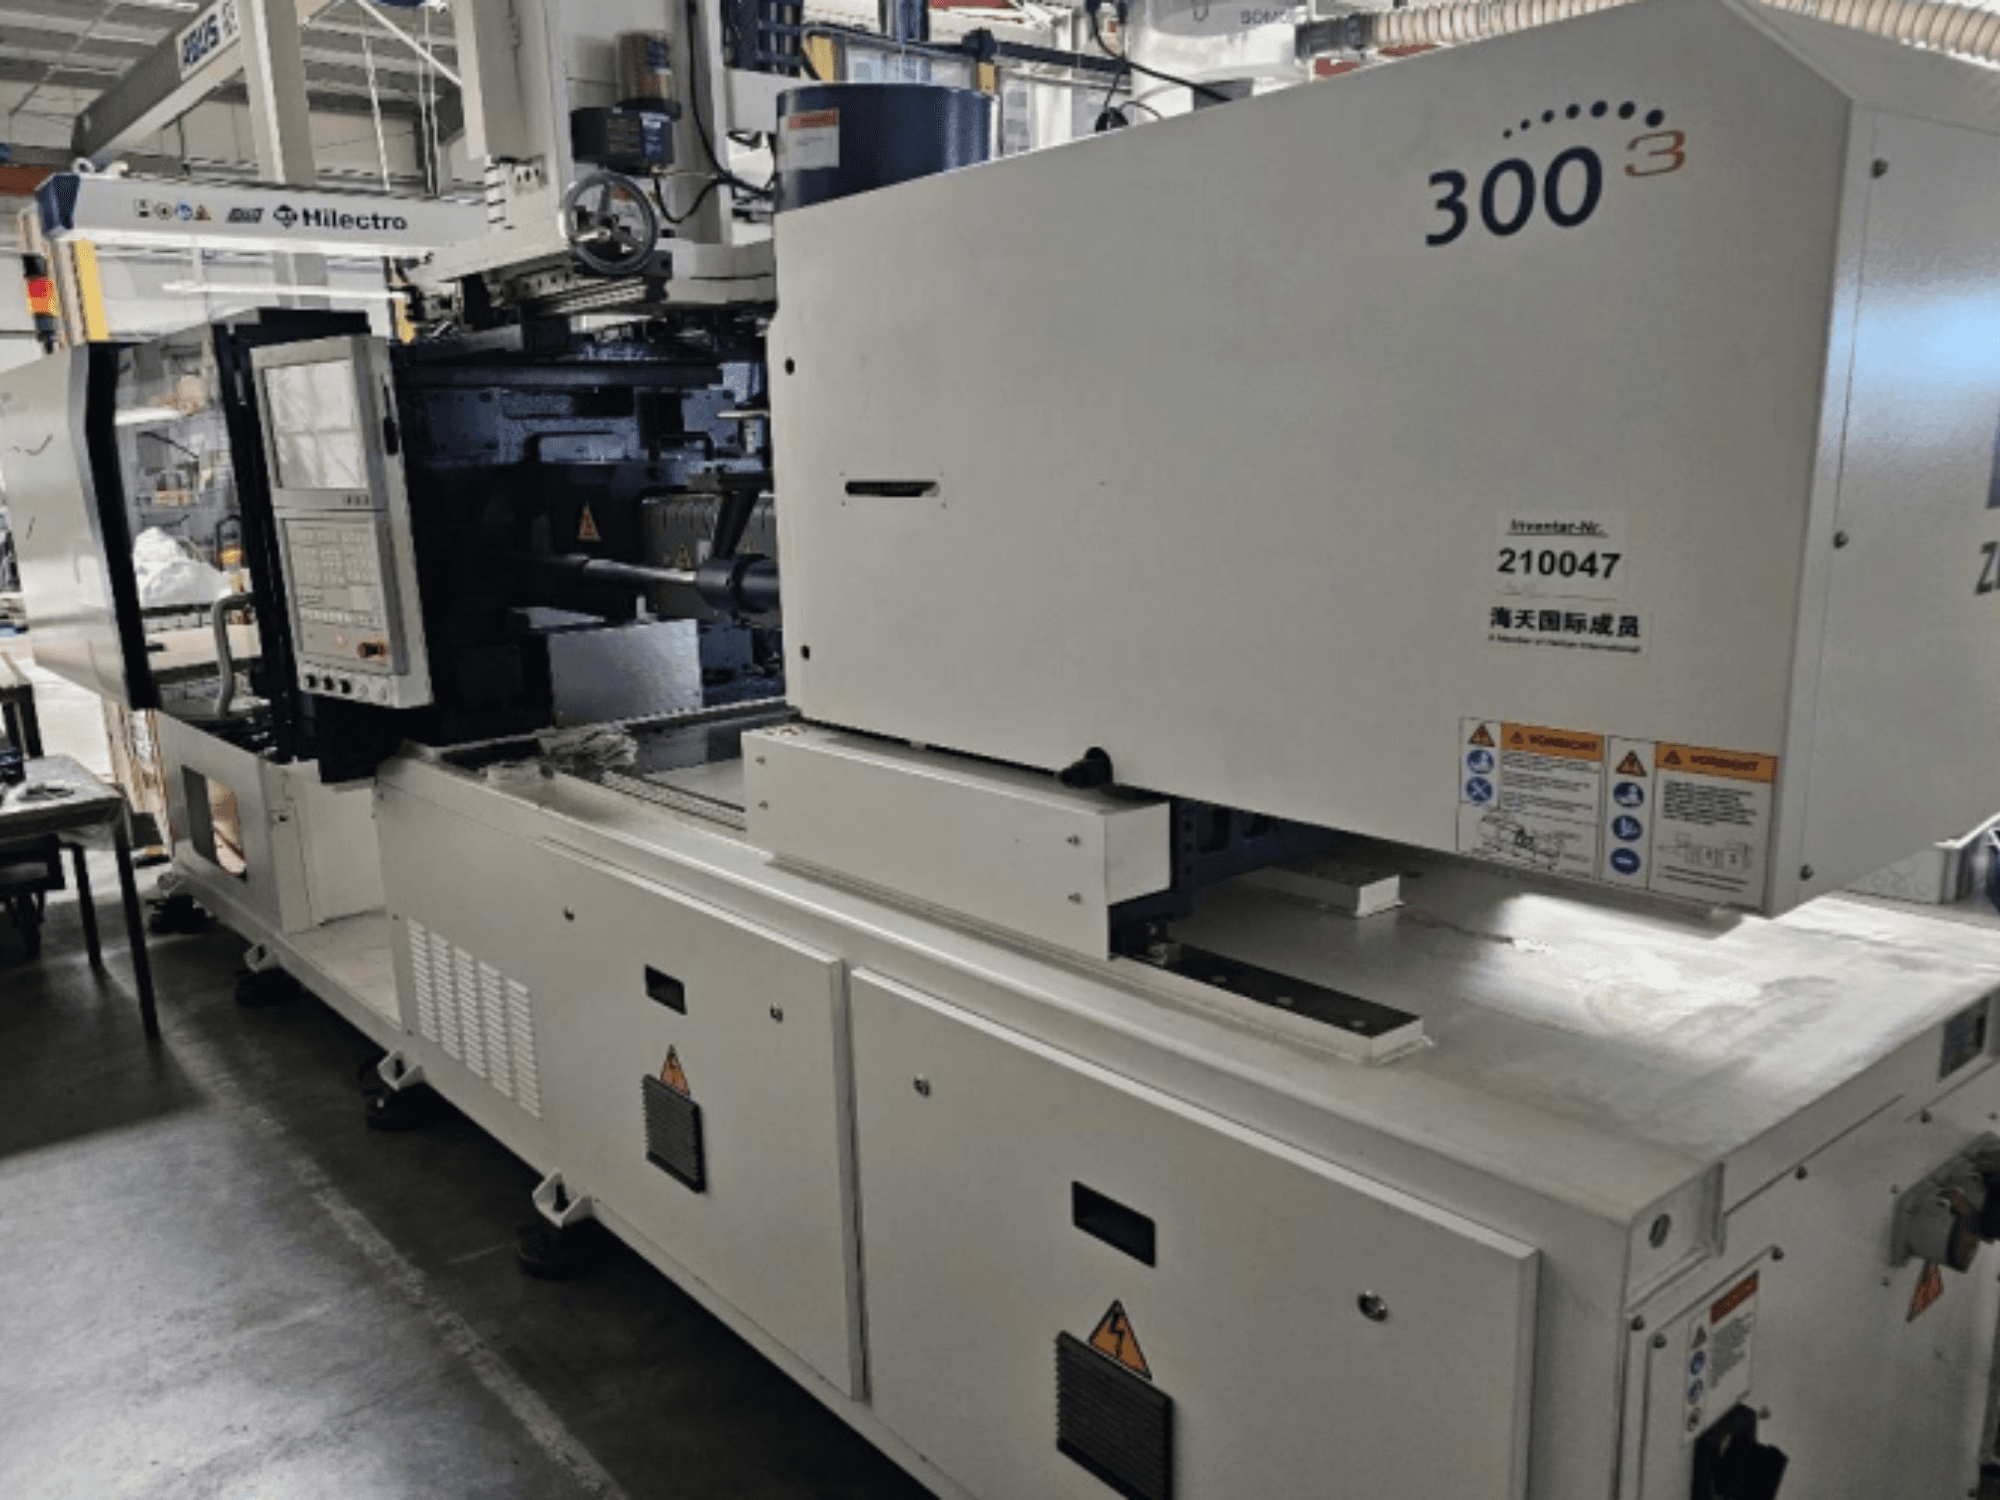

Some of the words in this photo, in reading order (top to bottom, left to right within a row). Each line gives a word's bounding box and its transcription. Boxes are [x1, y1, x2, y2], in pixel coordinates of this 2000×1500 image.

[1426, 146, 1602, 247] 300
[1624, 130, 1686, 177] 3
[302, 206, 408, 230] Hilectro
[1497, 547, 1622, 580] 210047
[1490, 606, 1640, 638] 海天国际成员
